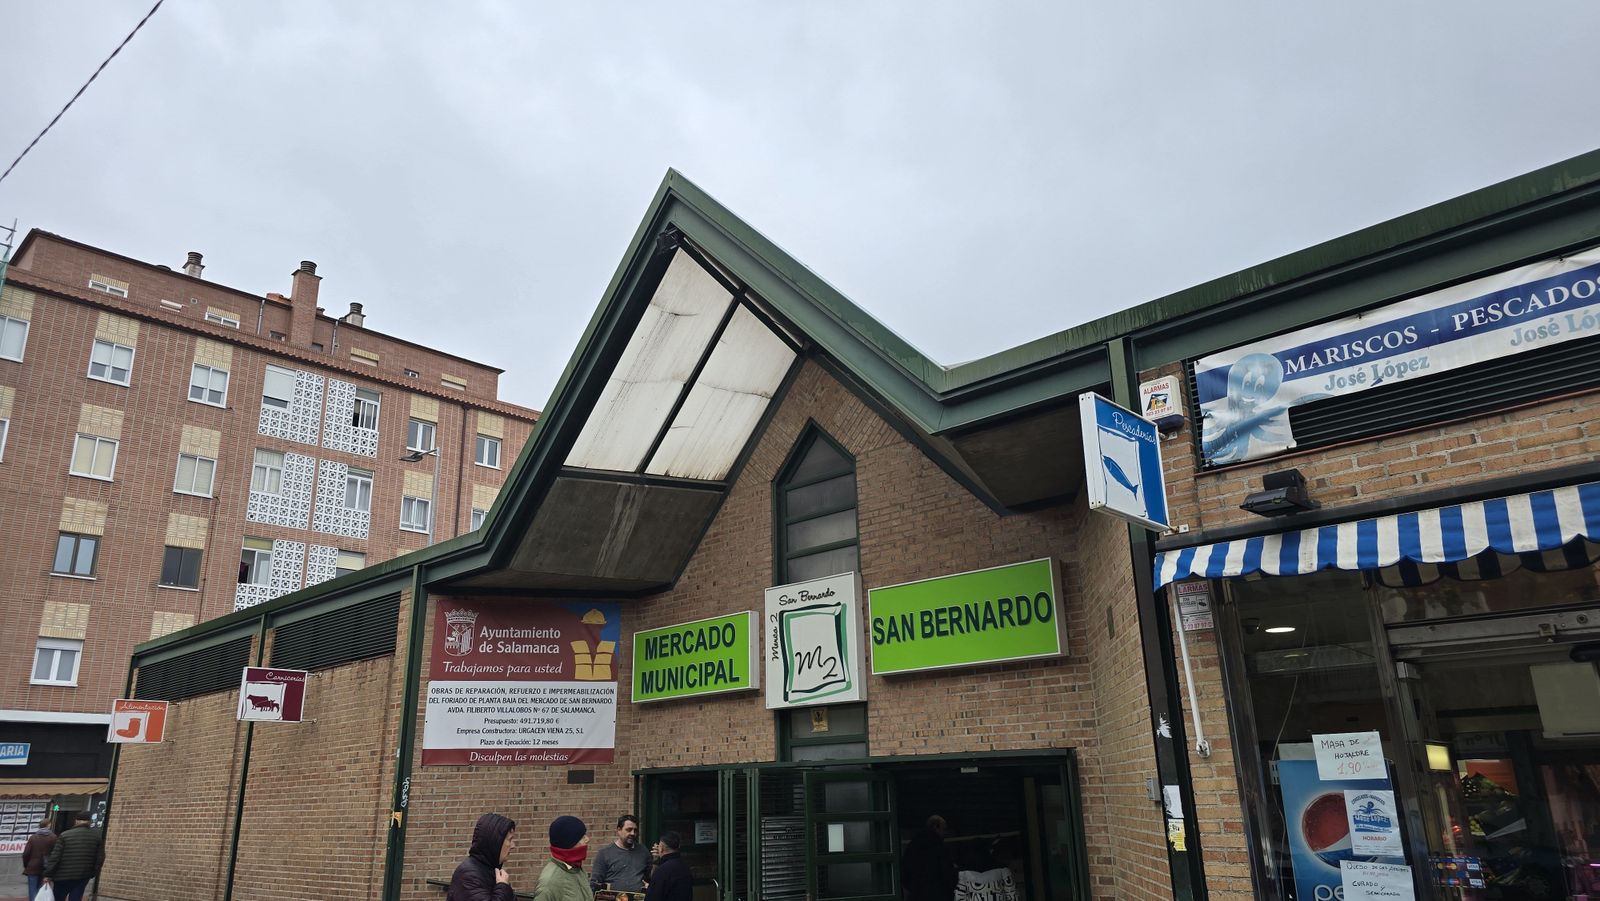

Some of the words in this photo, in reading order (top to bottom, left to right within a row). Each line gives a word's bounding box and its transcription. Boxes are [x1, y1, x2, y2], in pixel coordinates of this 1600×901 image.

[1510, 318, 1560, 347] José
[1284, 325, 1418, 375] MARISCOS
[1324, 366, 1366, 391] José
[1370, 356, 1430, 381] López
[1144, 383, 1169, 395] ALARMAS
[1178, 583, 1209, 593] LARMAS
[779, 594, 797, 606] San
[798, 588, 835, 601] Bernardo
[770, 612, 778, 623] 2
[872, 612, 915, 646] SAN
[920, 591, 1053, 639] BERNARDO
[480, 626, 561, 640] Ayuntamiento
[478, 641, 493, 653] de
[496, 641, 560, 654] Salamanca
[645, 622, 736, 661] MERCADO
[442, 660, 504, 676] Trabajamos
[506, 664, 531, 677] para
[534, 662, 562, 674] usted
[641, 658, 740, 695] MUNICIPAL
[431, 687, 453, 695] OBRAS
[508, 687, 541, 695] REFUERZO
[548, 687, 615, 695] IMPERMEABILIZACIÓN
[581, 697, 614, 705] BERNARDO.
[483, 717, 519, 725] Presupuesto:
[519, 717, 554, 725] 491.719,80
[456, 727, 480, 736] Empresa
[479, 738, 496, 746] Plazo
[504, 738, 531, 747] Ejecución:
[1320, 740, 1345, 749] MASA
[1349, 738, 1360, 746] DE
[469, 750, 512, 765] Disculpen
[514, 750, 527, 761] las
[529, 750, 569, 761] molestias
[1334, 749, 1370, 760] HOJALDRE
